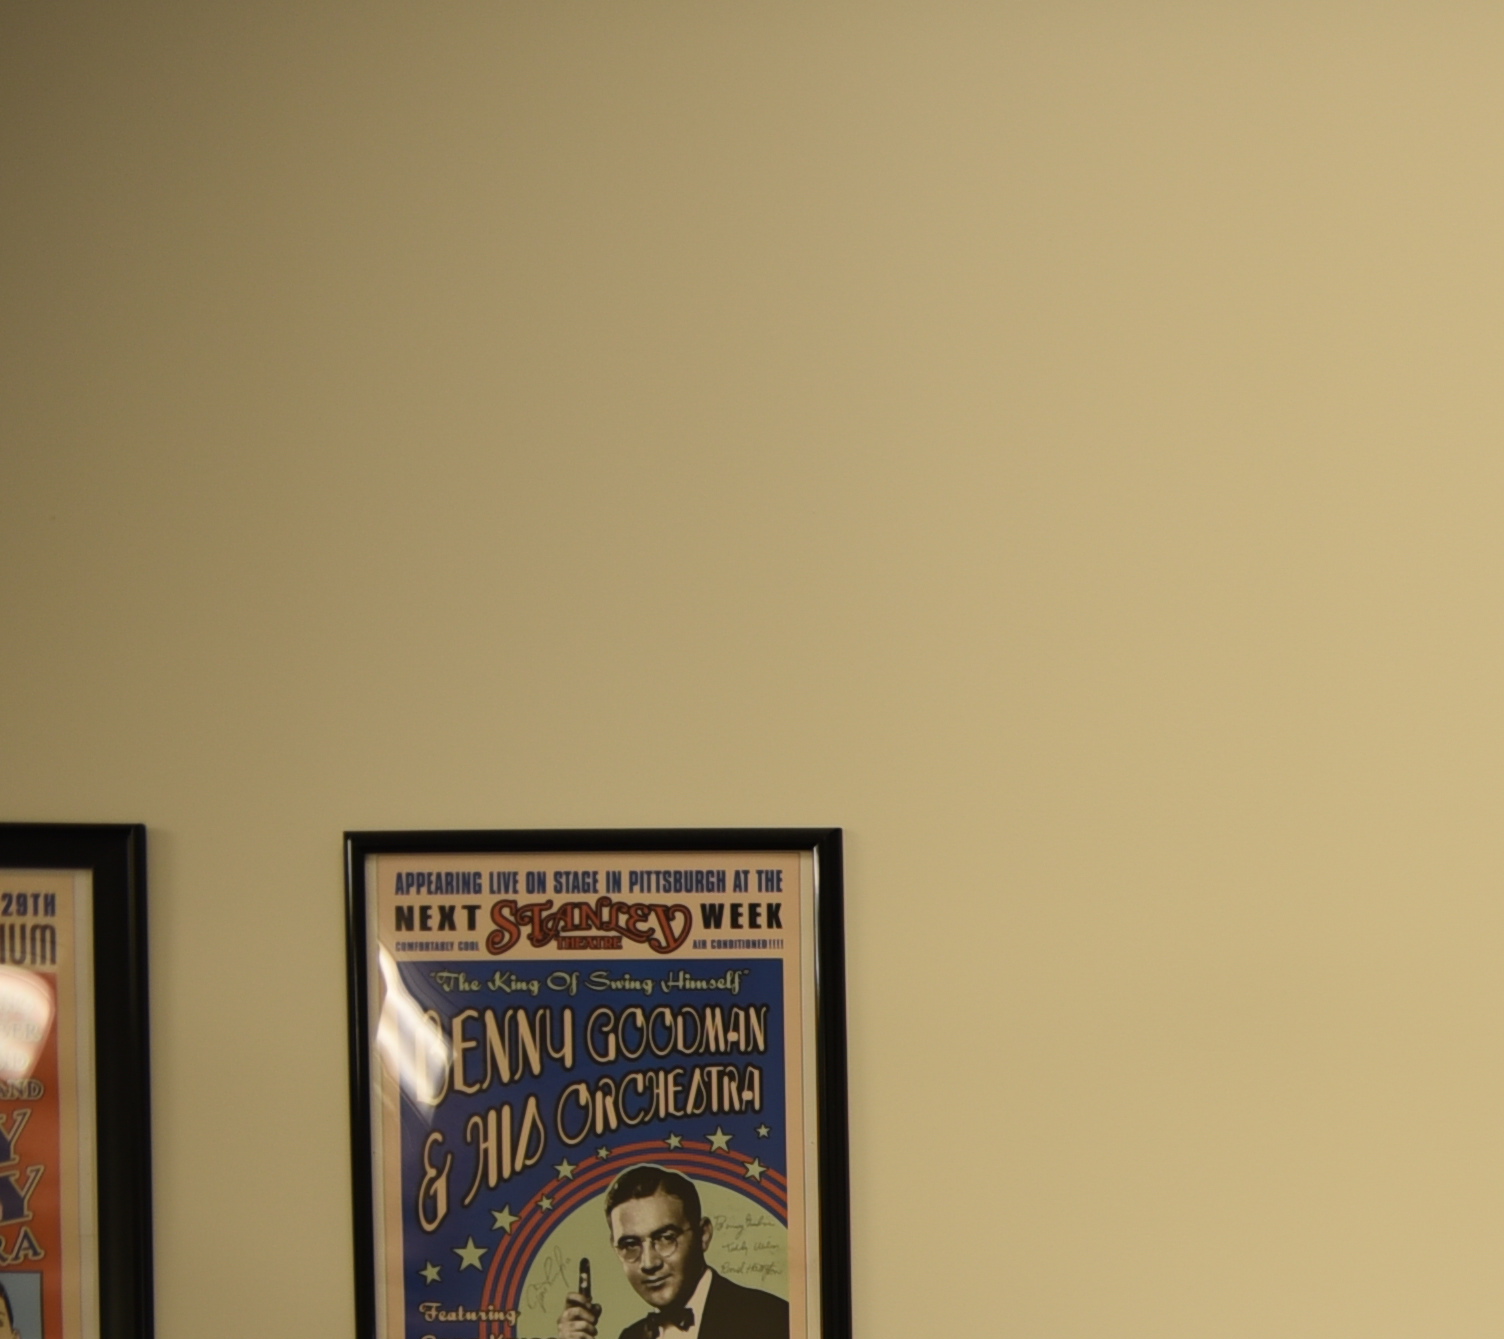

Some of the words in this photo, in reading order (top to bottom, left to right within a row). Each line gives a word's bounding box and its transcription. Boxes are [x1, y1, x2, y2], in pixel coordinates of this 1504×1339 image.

[395, 871, 482, 896] APPEARING
[489, 870, 519, 895] LIVE
[525, 870, 547, 895] ON
[553, 870, 599, 894] STAGE
[605, 870, 622, 894] IN
[629, 869, 726, 894] PITTSBURGH
[732, 869, 751, 893] AT
[756, 869, 783, 893] THE
[395, 904, 481, 932] NEXT
[485, 895, 692, 956] STANLEY
[700, 902, 783, 930] WEEK
[395, 941, 454, 952] COMFORTABLY
[457, 940, 480, 952] COOL
[554, 935, 624, 951] THEATRE
[692, 939, 708, 950] AIR
[487, 971, 541, 996] King
[546, 970, 580, 996] Of
[584, 969, 654, 997] Swing
[586, 1005, 769, 1063] GOODMAN
[417, 1131, 453, 1233] &
[462, 1095, 547, 1206] HIS
[556, 1065, 764, 1146] ORCHESTRA
[418, 1301, 520, 1326] Featuring
